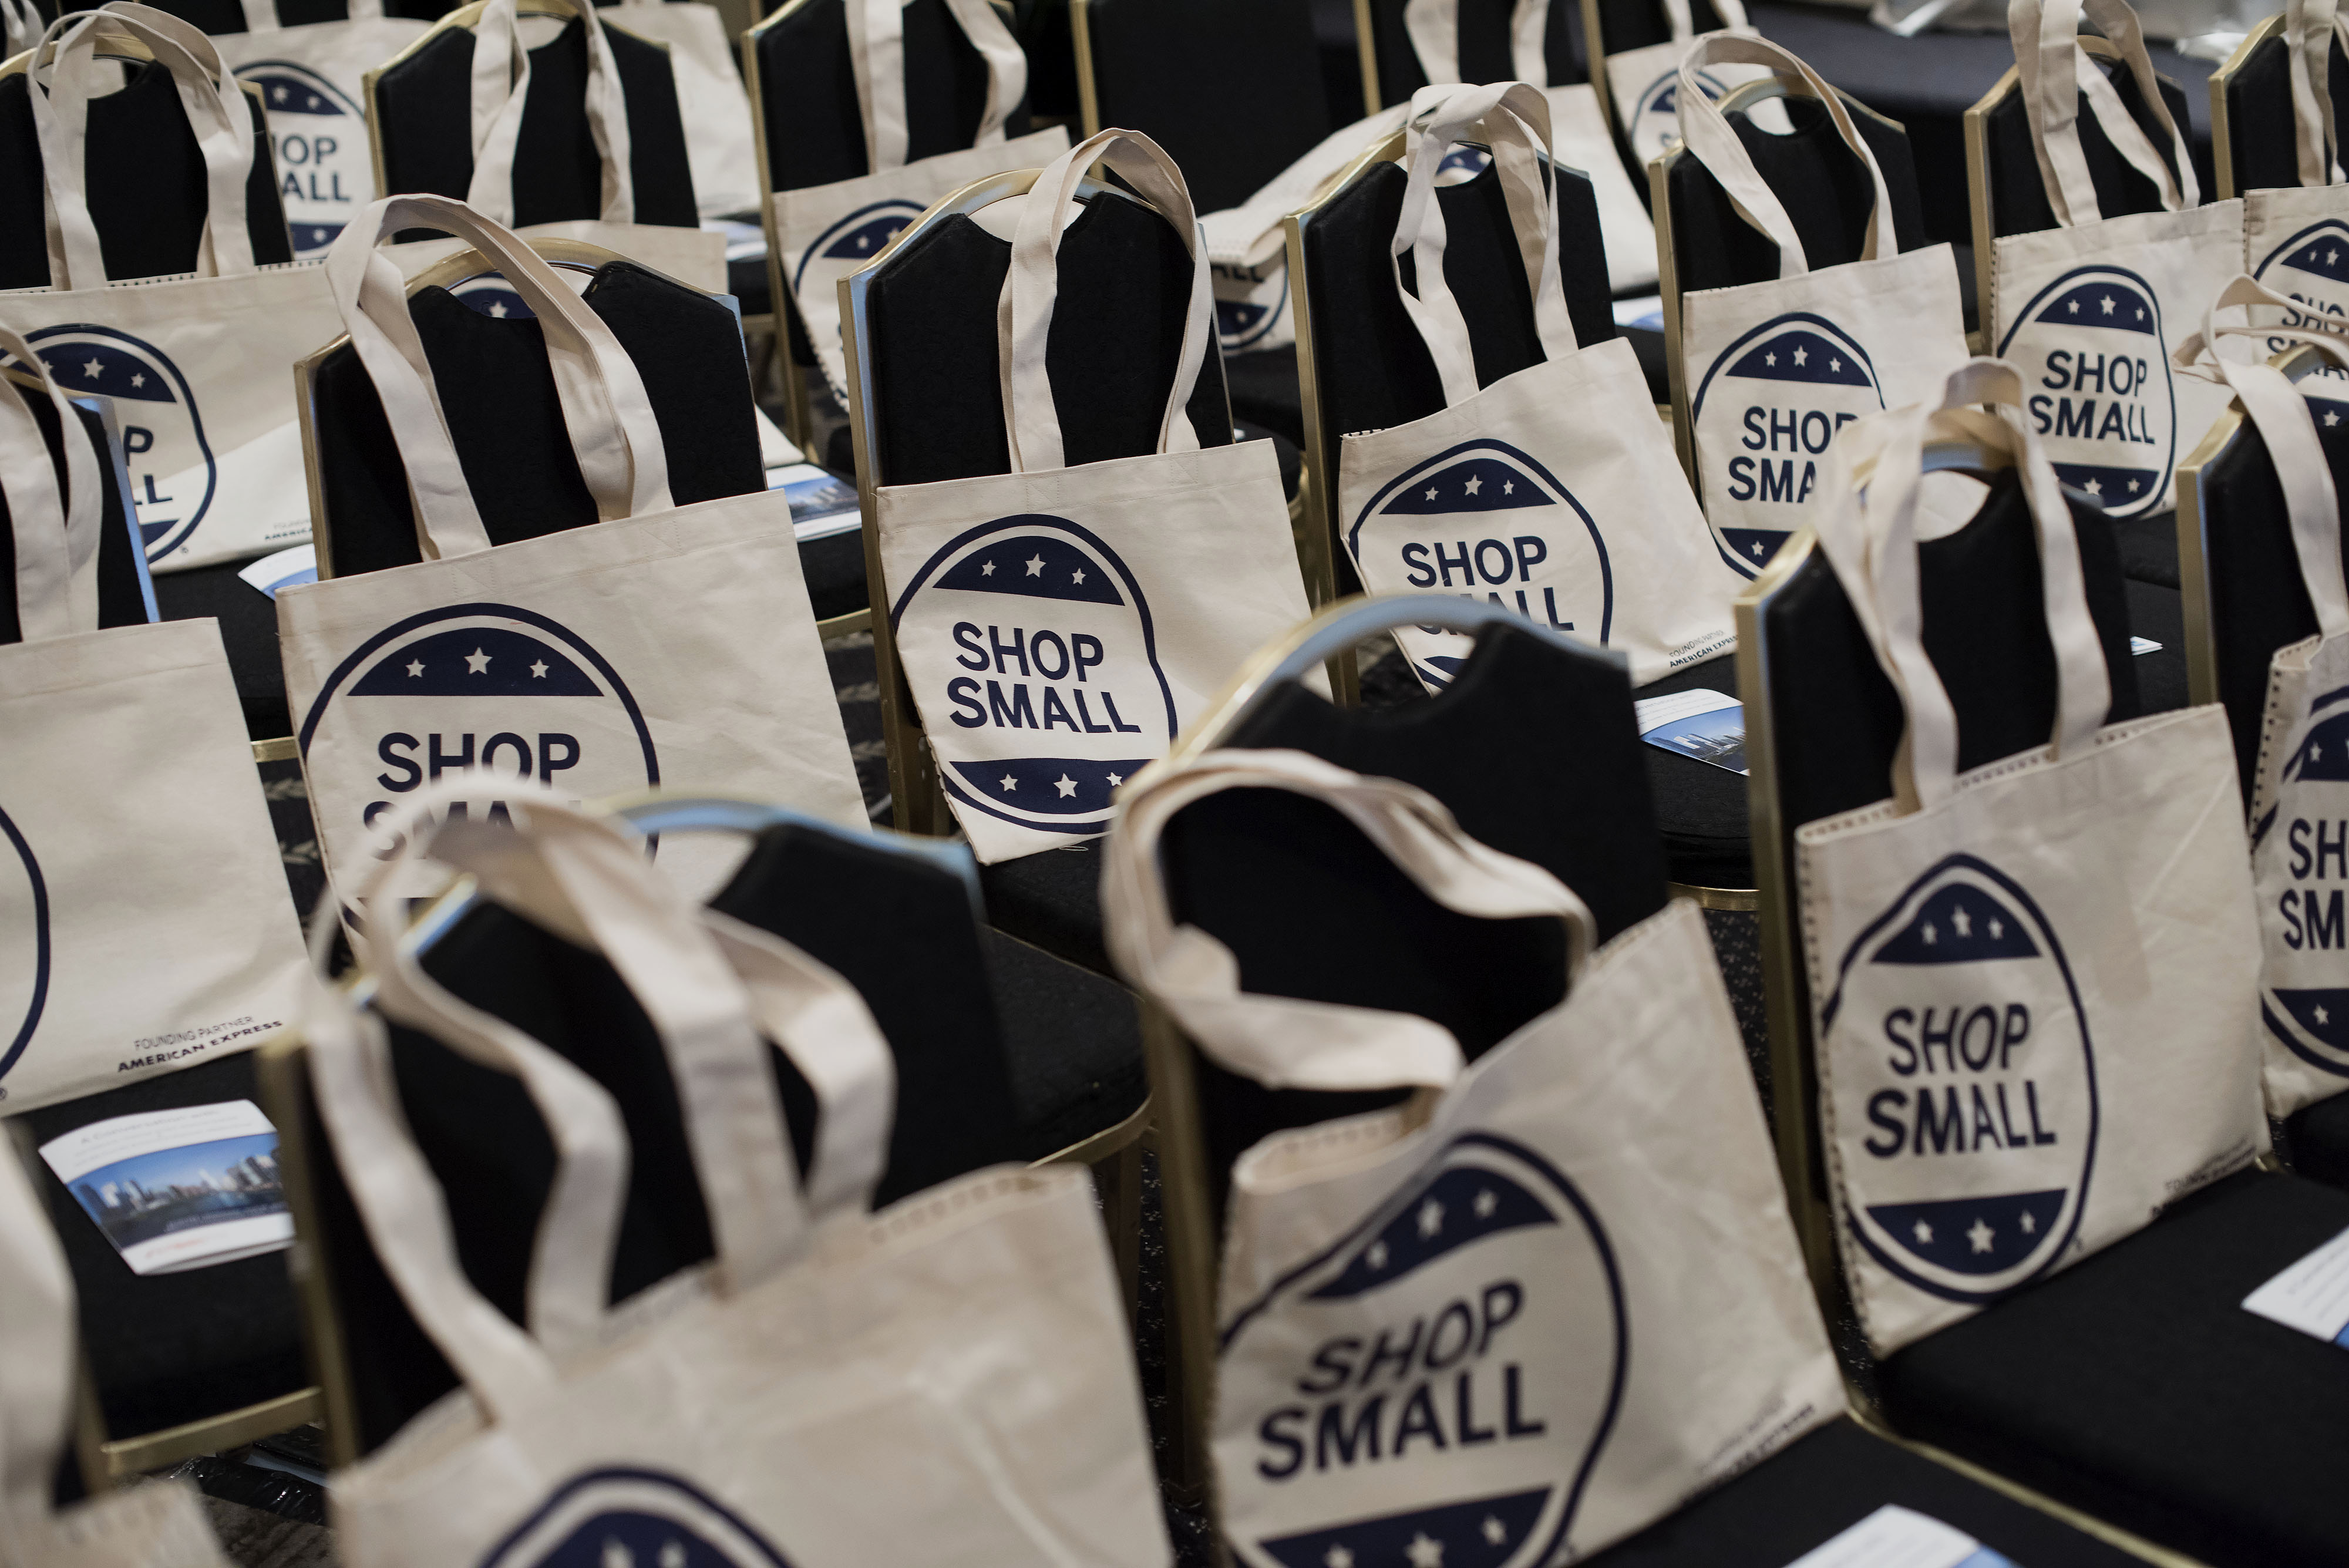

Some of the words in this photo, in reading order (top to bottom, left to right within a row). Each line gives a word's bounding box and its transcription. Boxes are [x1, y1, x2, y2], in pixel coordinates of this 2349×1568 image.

[271, 134, 337, 164] OP
[282, 172, 352, 201] ALL
[2041, 349, 2147, 397] SHOP
[2029, 394, 2156, 445] SMALL
[1728, 456, 1816, 503] SMA
[1401, 536, 1547, 588] SHOP
[953, 621, 1104, 682] SHOP
[1670, 647, 1713, 668] AMERICAN
[947, 677, 1142, 733] SMALL
[377, 732, 581, 793] SHOP
[2289, 818, 2349, 880] SH
[117, 1043, 206, 1073] AMERICAN
[210, 1020, 282, 1046] EXPRESS
[134, 1030, 196, 1051] FOUNDING
[197, 1015, 253, 1038] PARTNER
[1884, 1002, 2031, 1076] SHOP
[1864, 1079, 2057, 1159] SMALL
[1298, 1278, 1525, 1397] SHOP
[1256, 1361, 1548, 1483] SMALL
